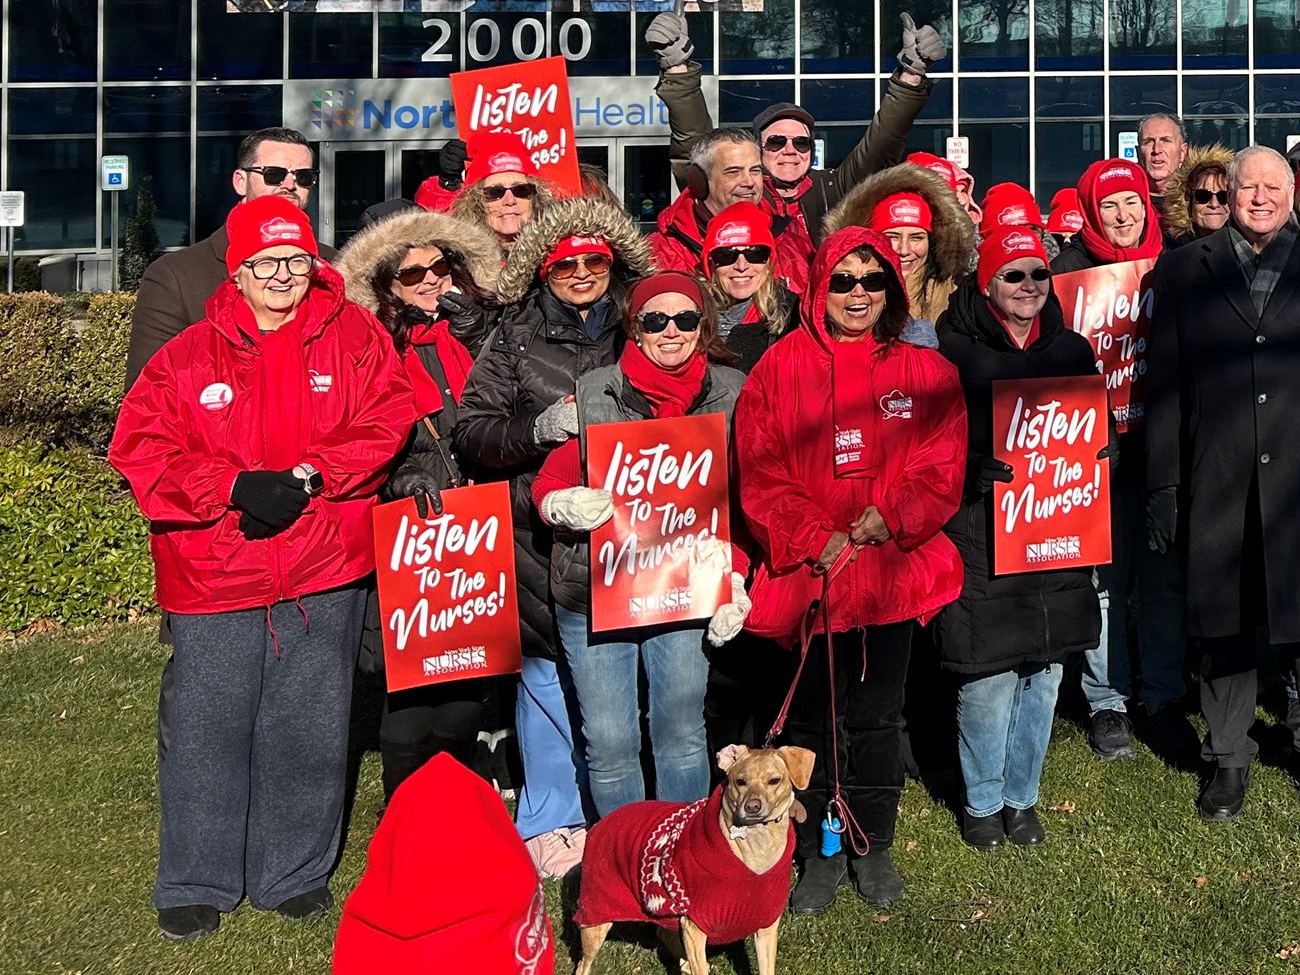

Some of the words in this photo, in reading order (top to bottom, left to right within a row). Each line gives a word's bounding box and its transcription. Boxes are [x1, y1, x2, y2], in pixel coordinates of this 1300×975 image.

[421, 18, 592, 62] 2000
[363, 98, 454, 130] Nort
[575, 95, 669, 126] Healt
[531, 127, 567, 170] ses!
[1001, 464, 1100, 534] Nurses!
[1026, 540, 1081, 558] NURSES
[1026, 552, 1082, 563] ASSOCIATION
[389, 572, 506, 651] Nurses!
[423, 650, 486, 672] NURSES
[424, 661, 488, 677] ASSOCIATION
